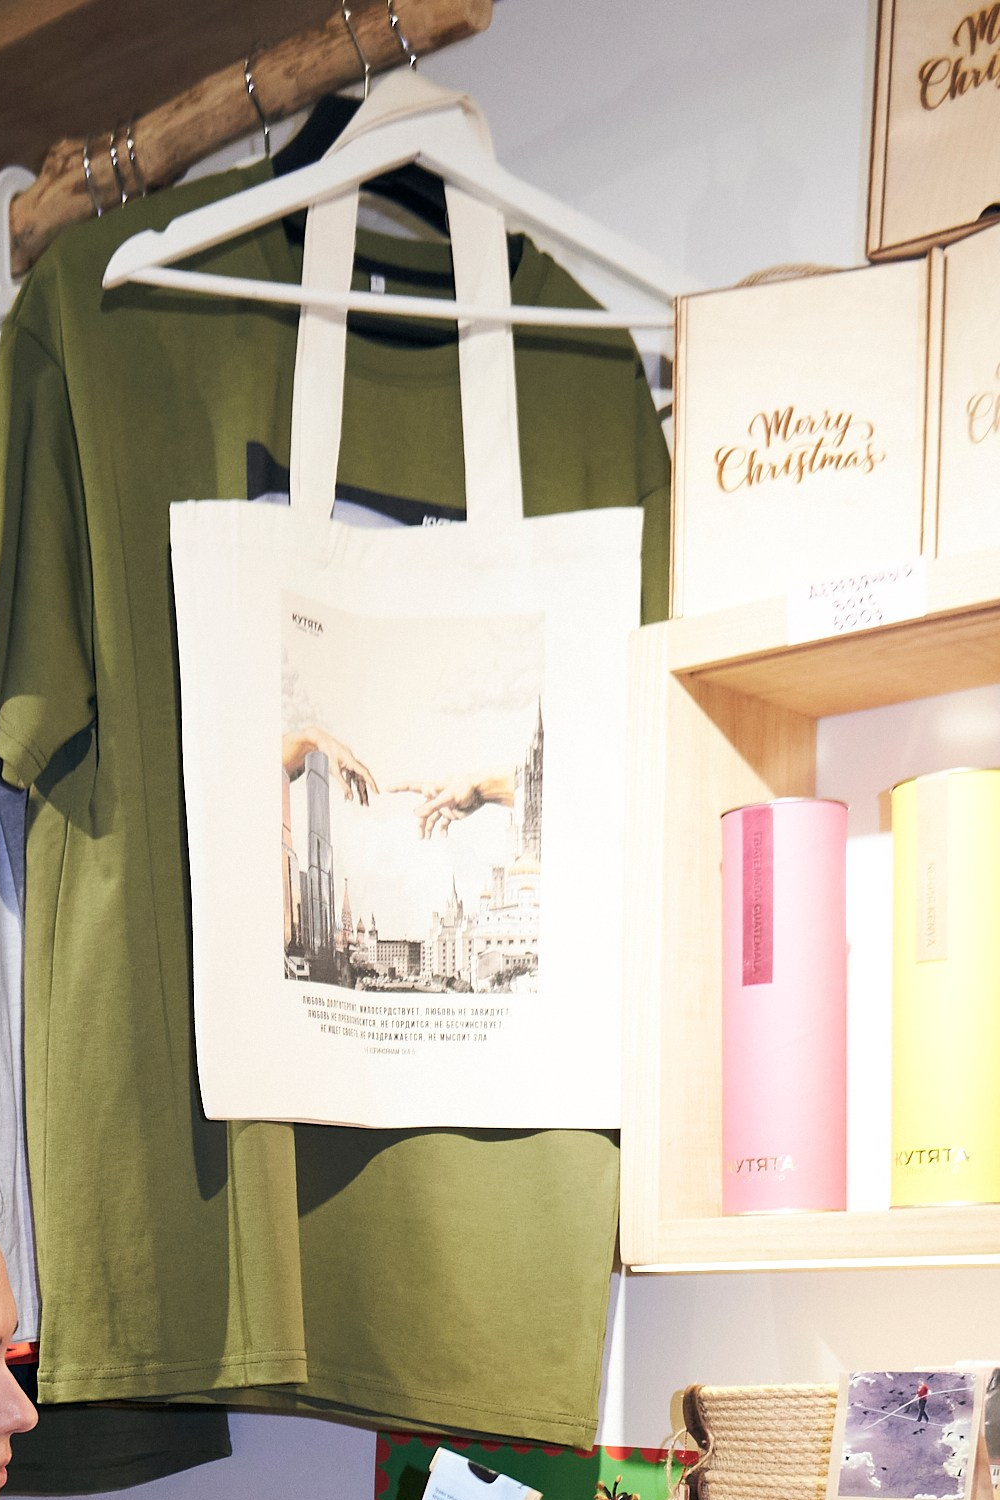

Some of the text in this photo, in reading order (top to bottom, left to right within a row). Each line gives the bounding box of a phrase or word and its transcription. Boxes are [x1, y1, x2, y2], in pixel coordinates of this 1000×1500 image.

[748, 404, 875, 448] Merry
[714, 436, 887, 494] Christmas
[291, 612, 324, 633] КУТЯТА
[752, 904, 763, 976] GUATEMALA
[302, 995, 325, 1007] ЛЮБОВЬ
[425, 1007, 456, 1016] ЛЮБОВЬ
[458, 1007, 467, 1016] НЕ
[308, 1009, 330, 1020] ЛЮБОВЬ
[380, 1020, 389, 1029] НЕ
[434, 1020, 443, 1029] НЕ
[428, 1033, 437, 1041] НЕ
[440, 1033, 470, 1041] МЫСЛИТ
[727, 1154, 797, 1174] КУТЯТА
[895, 1148, 970, 1167] КУТЯТА
